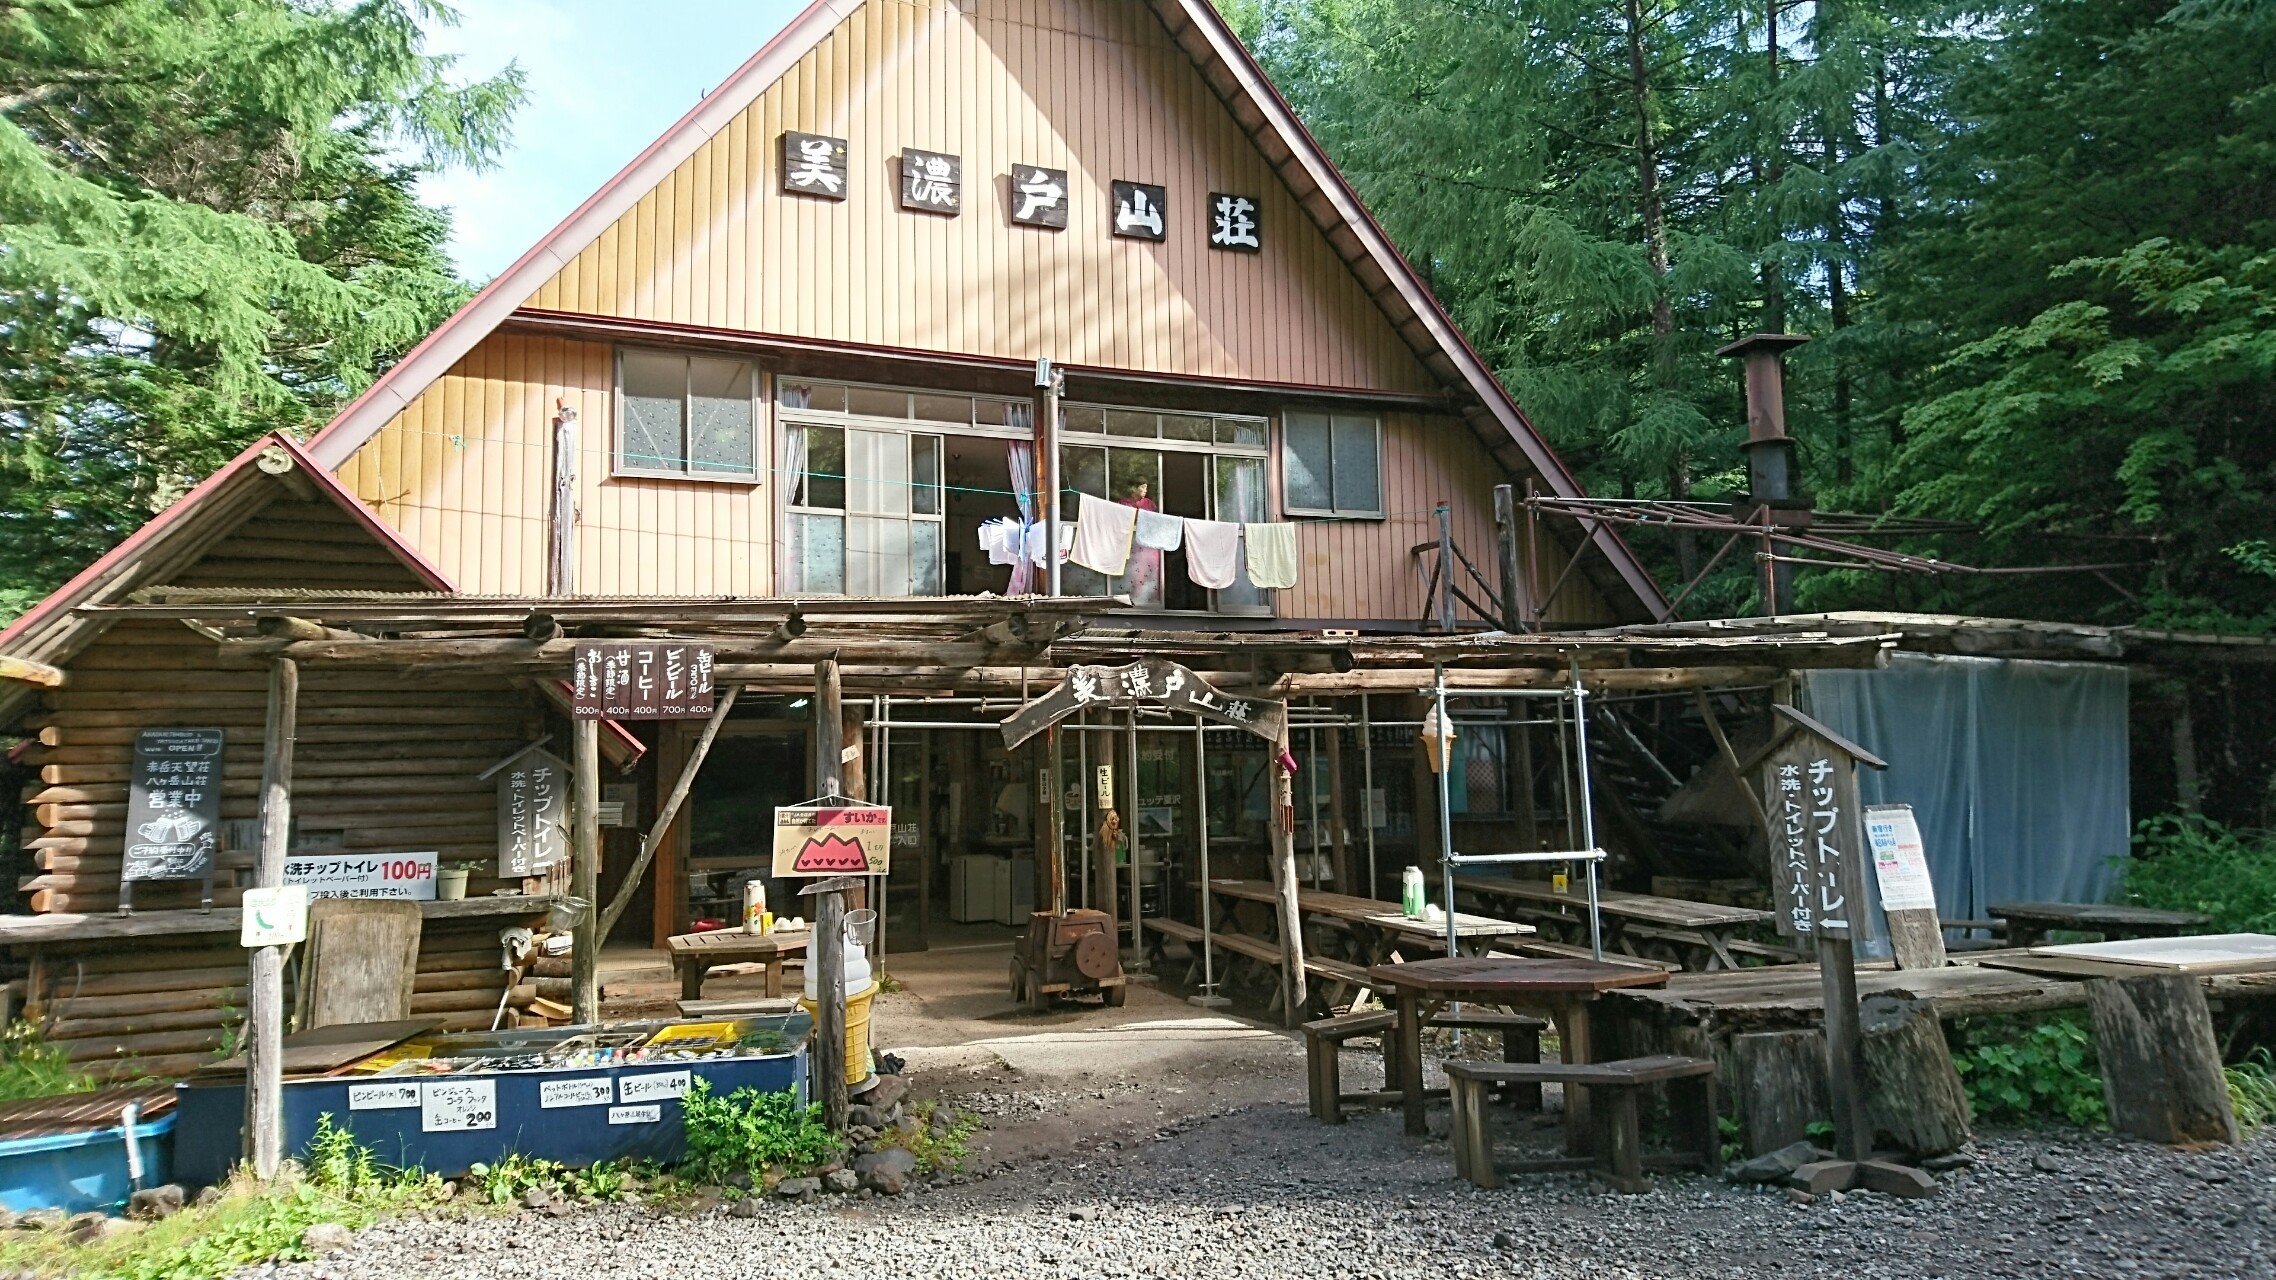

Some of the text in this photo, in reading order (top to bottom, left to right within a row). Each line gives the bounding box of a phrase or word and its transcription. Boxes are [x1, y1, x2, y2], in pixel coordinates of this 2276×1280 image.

[790, 139, 1259, 248] 美濃戸山荘
[587, 649, 601, 698] おしるこ
[616, 650, 631, 685] 甘酒
[638, 651, 653, 700] コーヒー
[575, 706, 600, 715] 500円
[606, 706, 630, 715] 400円
[633, 706, 658, 715] 400円
[662, 705, 686, 714] 700円
[689, 705, 713, 713] 400円
[146, 760, 211, 773] 赤岳天望荘
[1100, 768, 1111, 797] 生ビール
[148, 788, 202, 809] 営業中
[843, 811, 877, 824] すいか
[869, 857, 883, 865] 500
[381, 860, 432, 880] 100円
[669, 1078, 687, 1089] 400
[398, 1088, 416, 1100] 700
[592, 1086, 610, 1098] 300
[466, 1111, 492, 1127] 200
